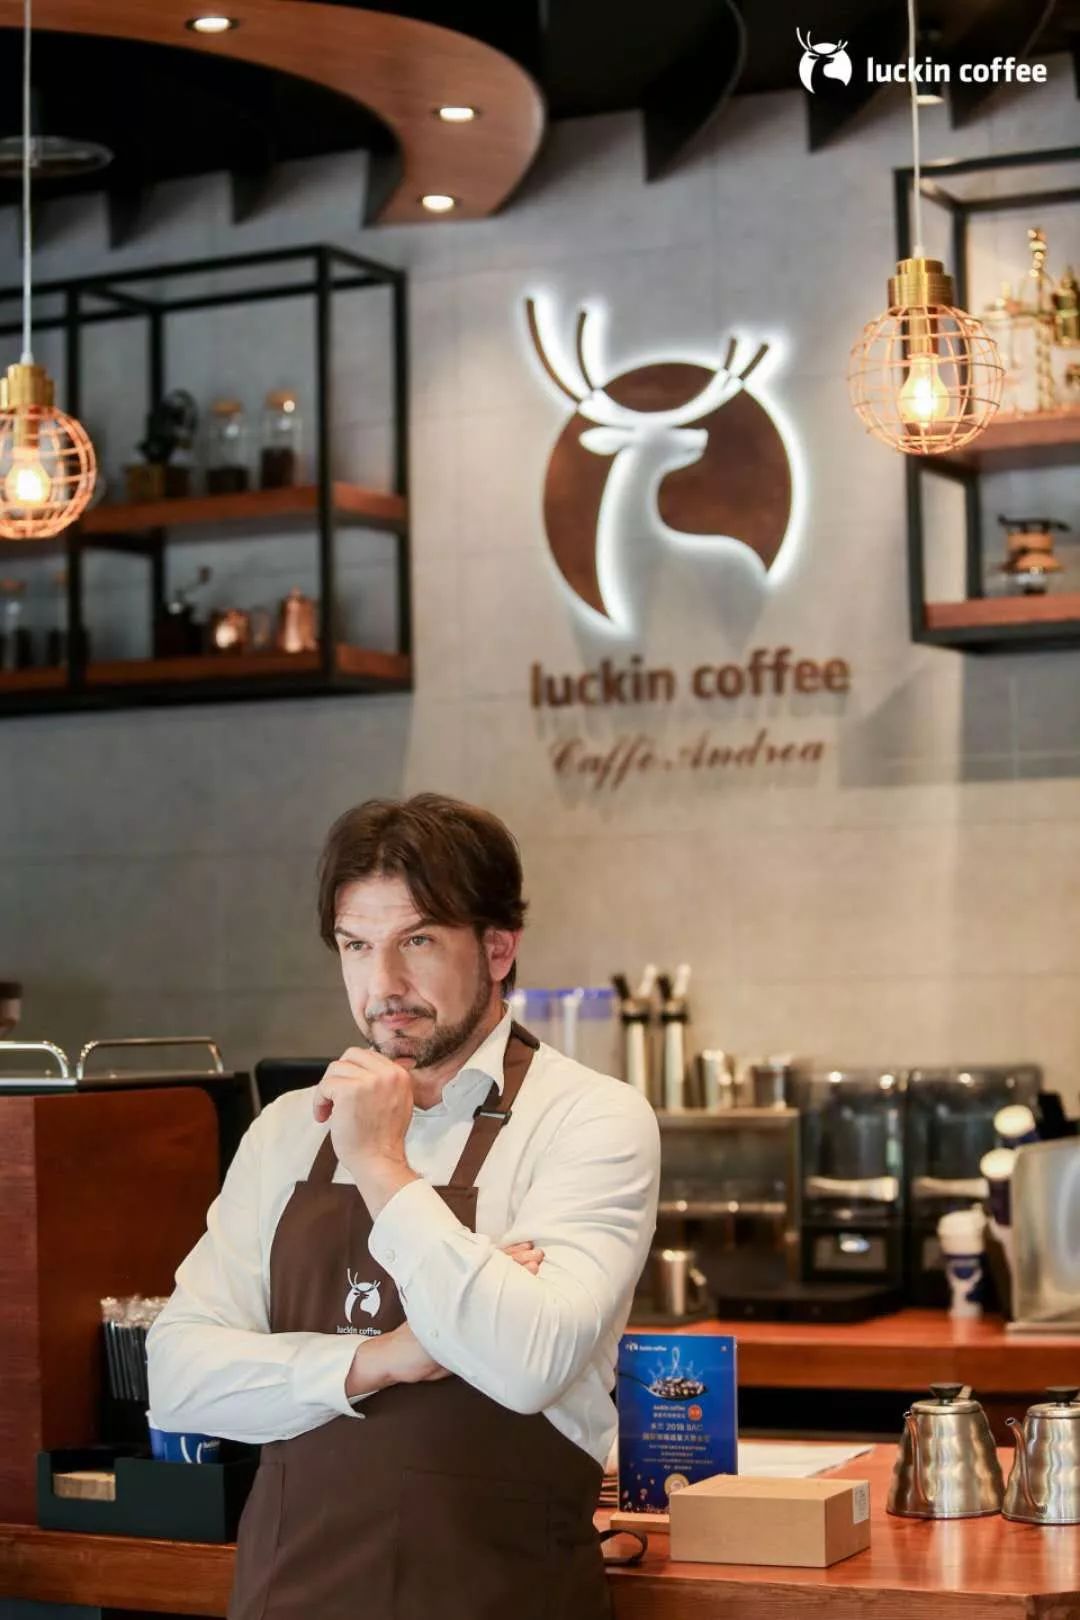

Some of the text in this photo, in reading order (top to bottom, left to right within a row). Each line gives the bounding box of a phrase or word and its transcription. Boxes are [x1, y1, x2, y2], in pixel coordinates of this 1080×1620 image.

[530, 647, 851, 709] luckin coffee
[336, 1325, 382, 1336] luckin coffee
